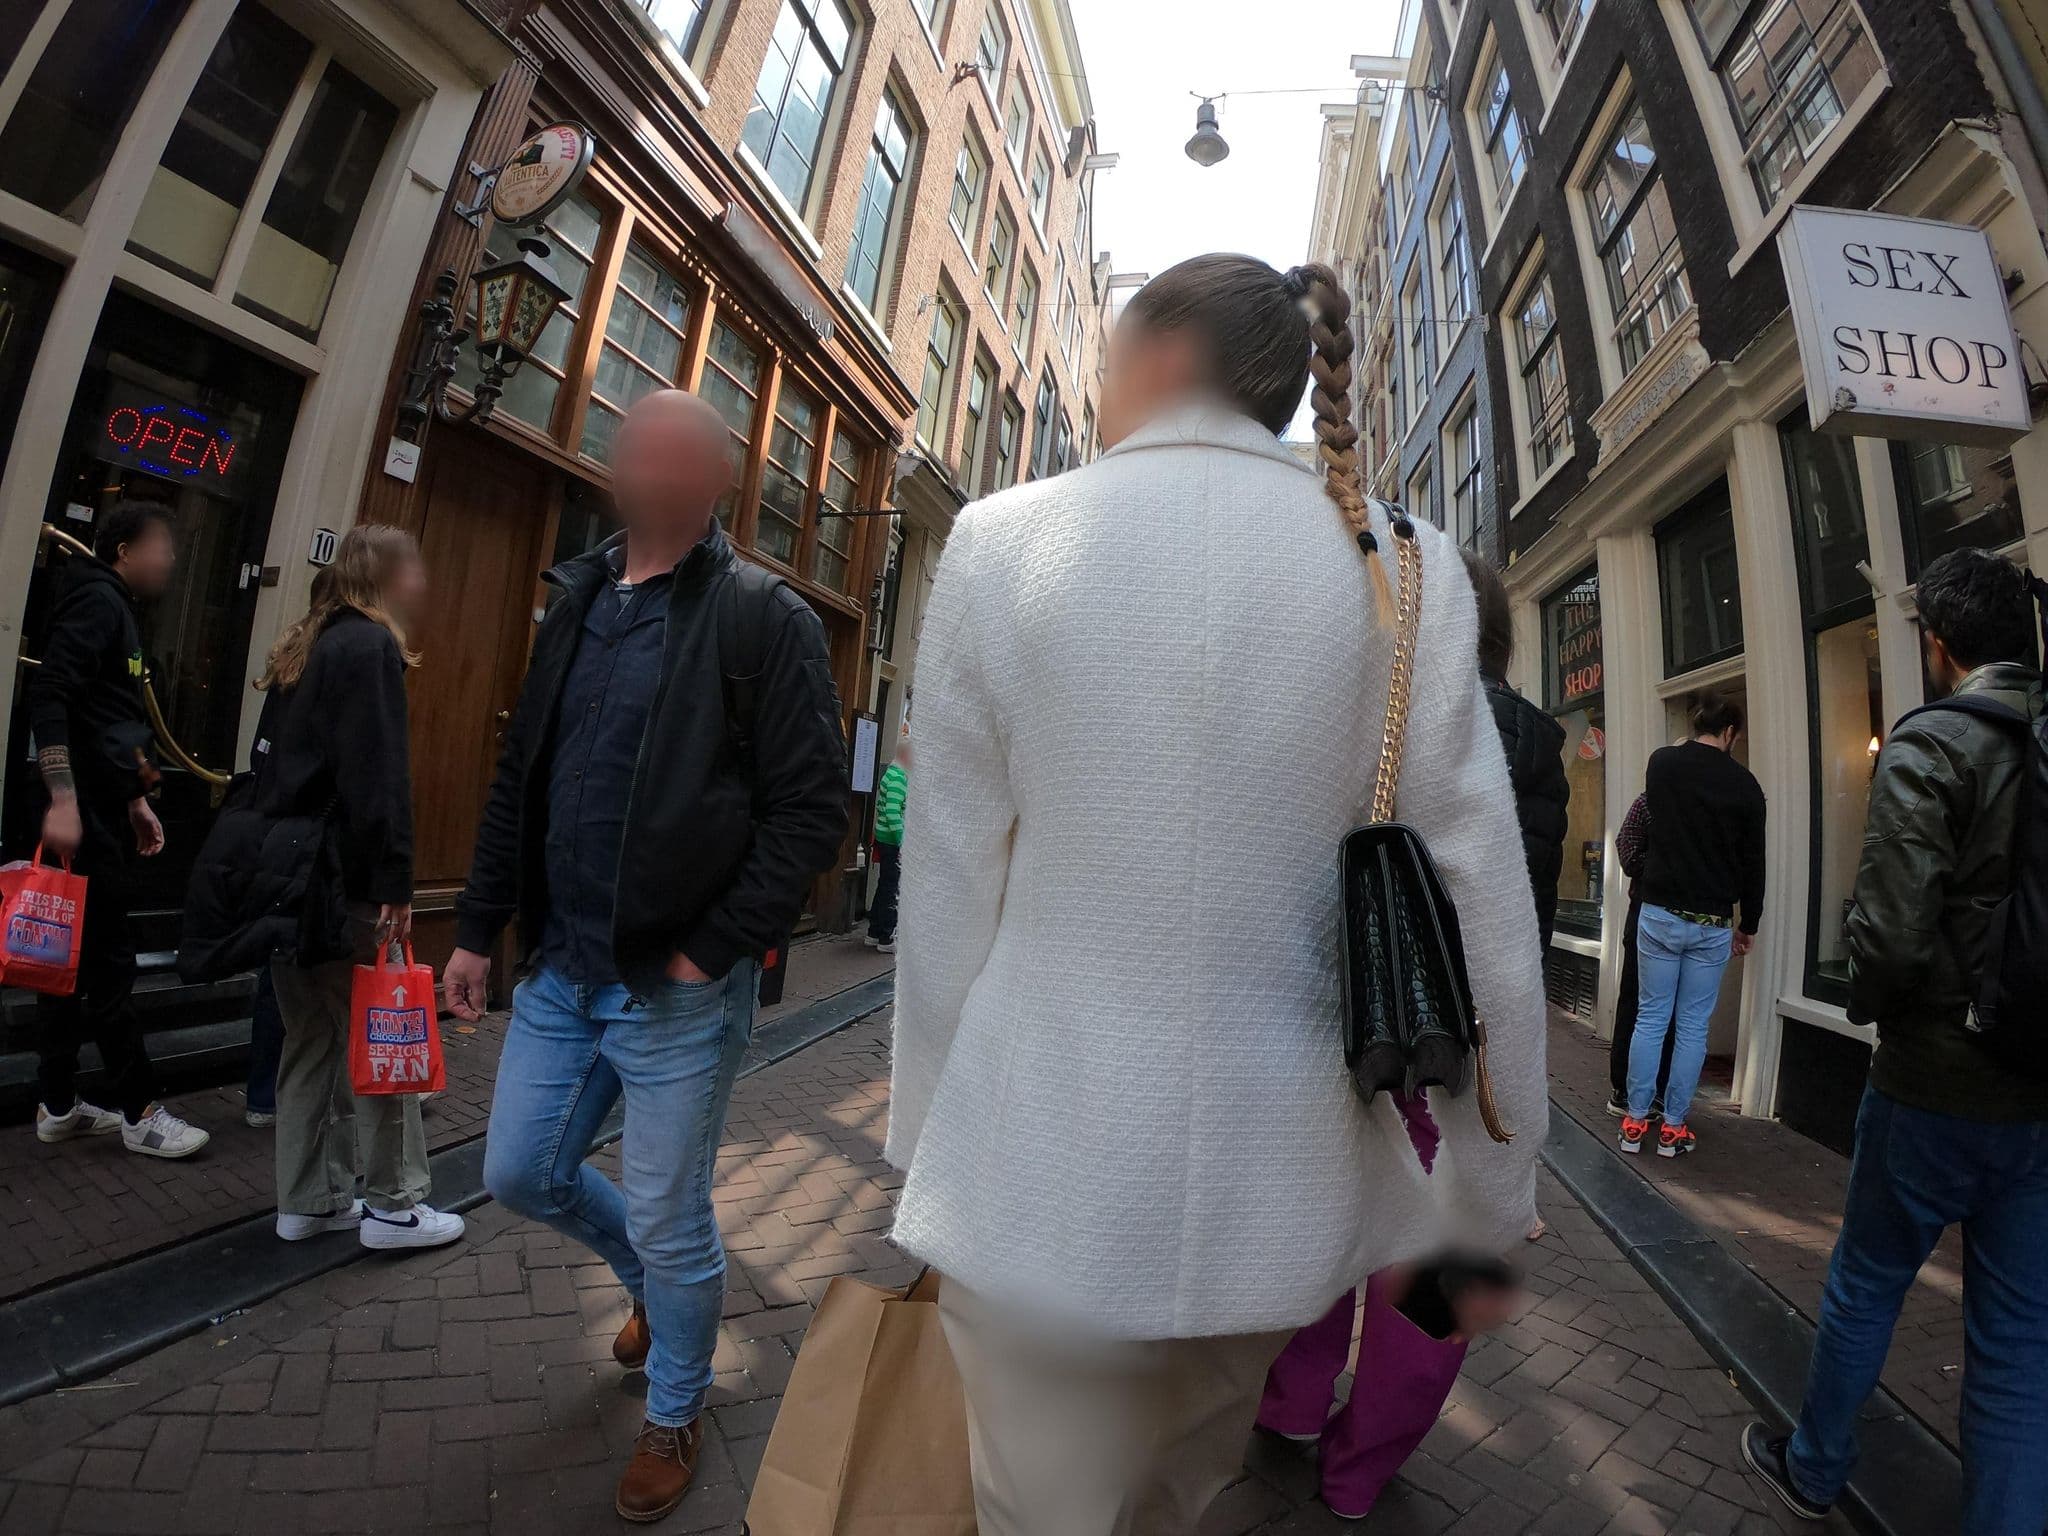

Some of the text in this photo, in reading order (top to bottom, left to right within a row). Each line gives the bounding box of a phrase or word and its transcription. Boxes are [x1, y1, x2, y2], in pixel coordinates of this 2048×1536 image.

[1842, 243, 1972, 299] SEX
[1833, 325, 2007, 389] SHOP
[108, 407, 237, 475] OPEN
[313, 532, 335, 562] 10
[1560, 626, 1602, 665] HAPPY
[1565, 663, 1601, 697] SHOP
[52, 895, 76, 913] BAG
[368, 1043, 429, 1058] SERIOUS
[368, 1054, 430, 1082] FAN
